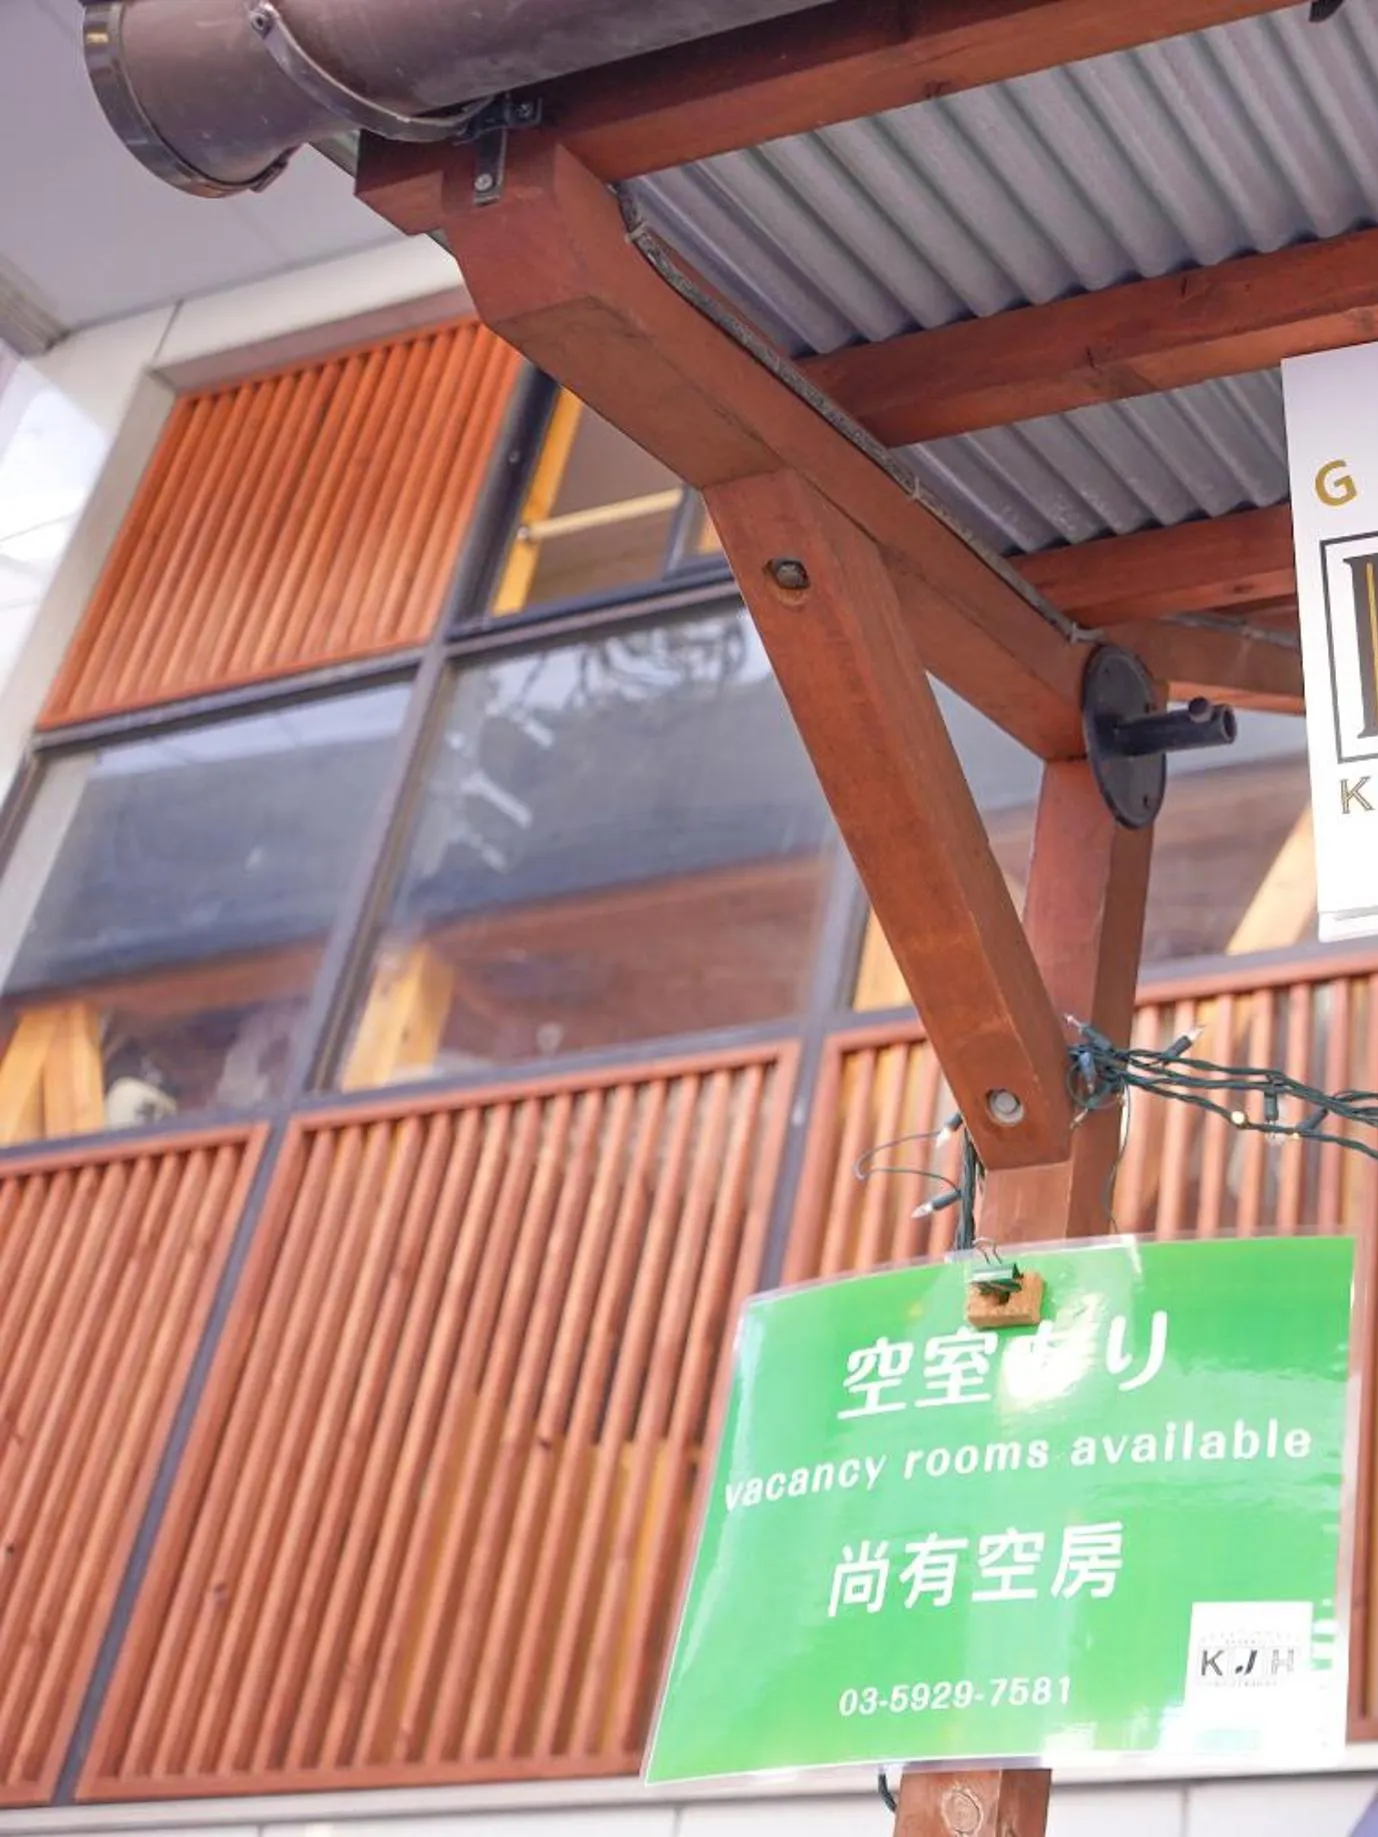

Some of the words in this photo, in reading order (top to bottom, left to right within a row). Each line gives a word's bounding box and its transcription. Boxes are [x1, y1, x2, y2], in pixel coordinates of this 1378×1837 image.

[723, 1453, 887, 1511] vacancy
[903, 1437, 1049, 1481] rooms
[1070, 1417, 1313, 1467] available
[826, 1520, 1125, 1618] 尚有空房
[837, 1674, 1073, 1717] 03-5929-7581
